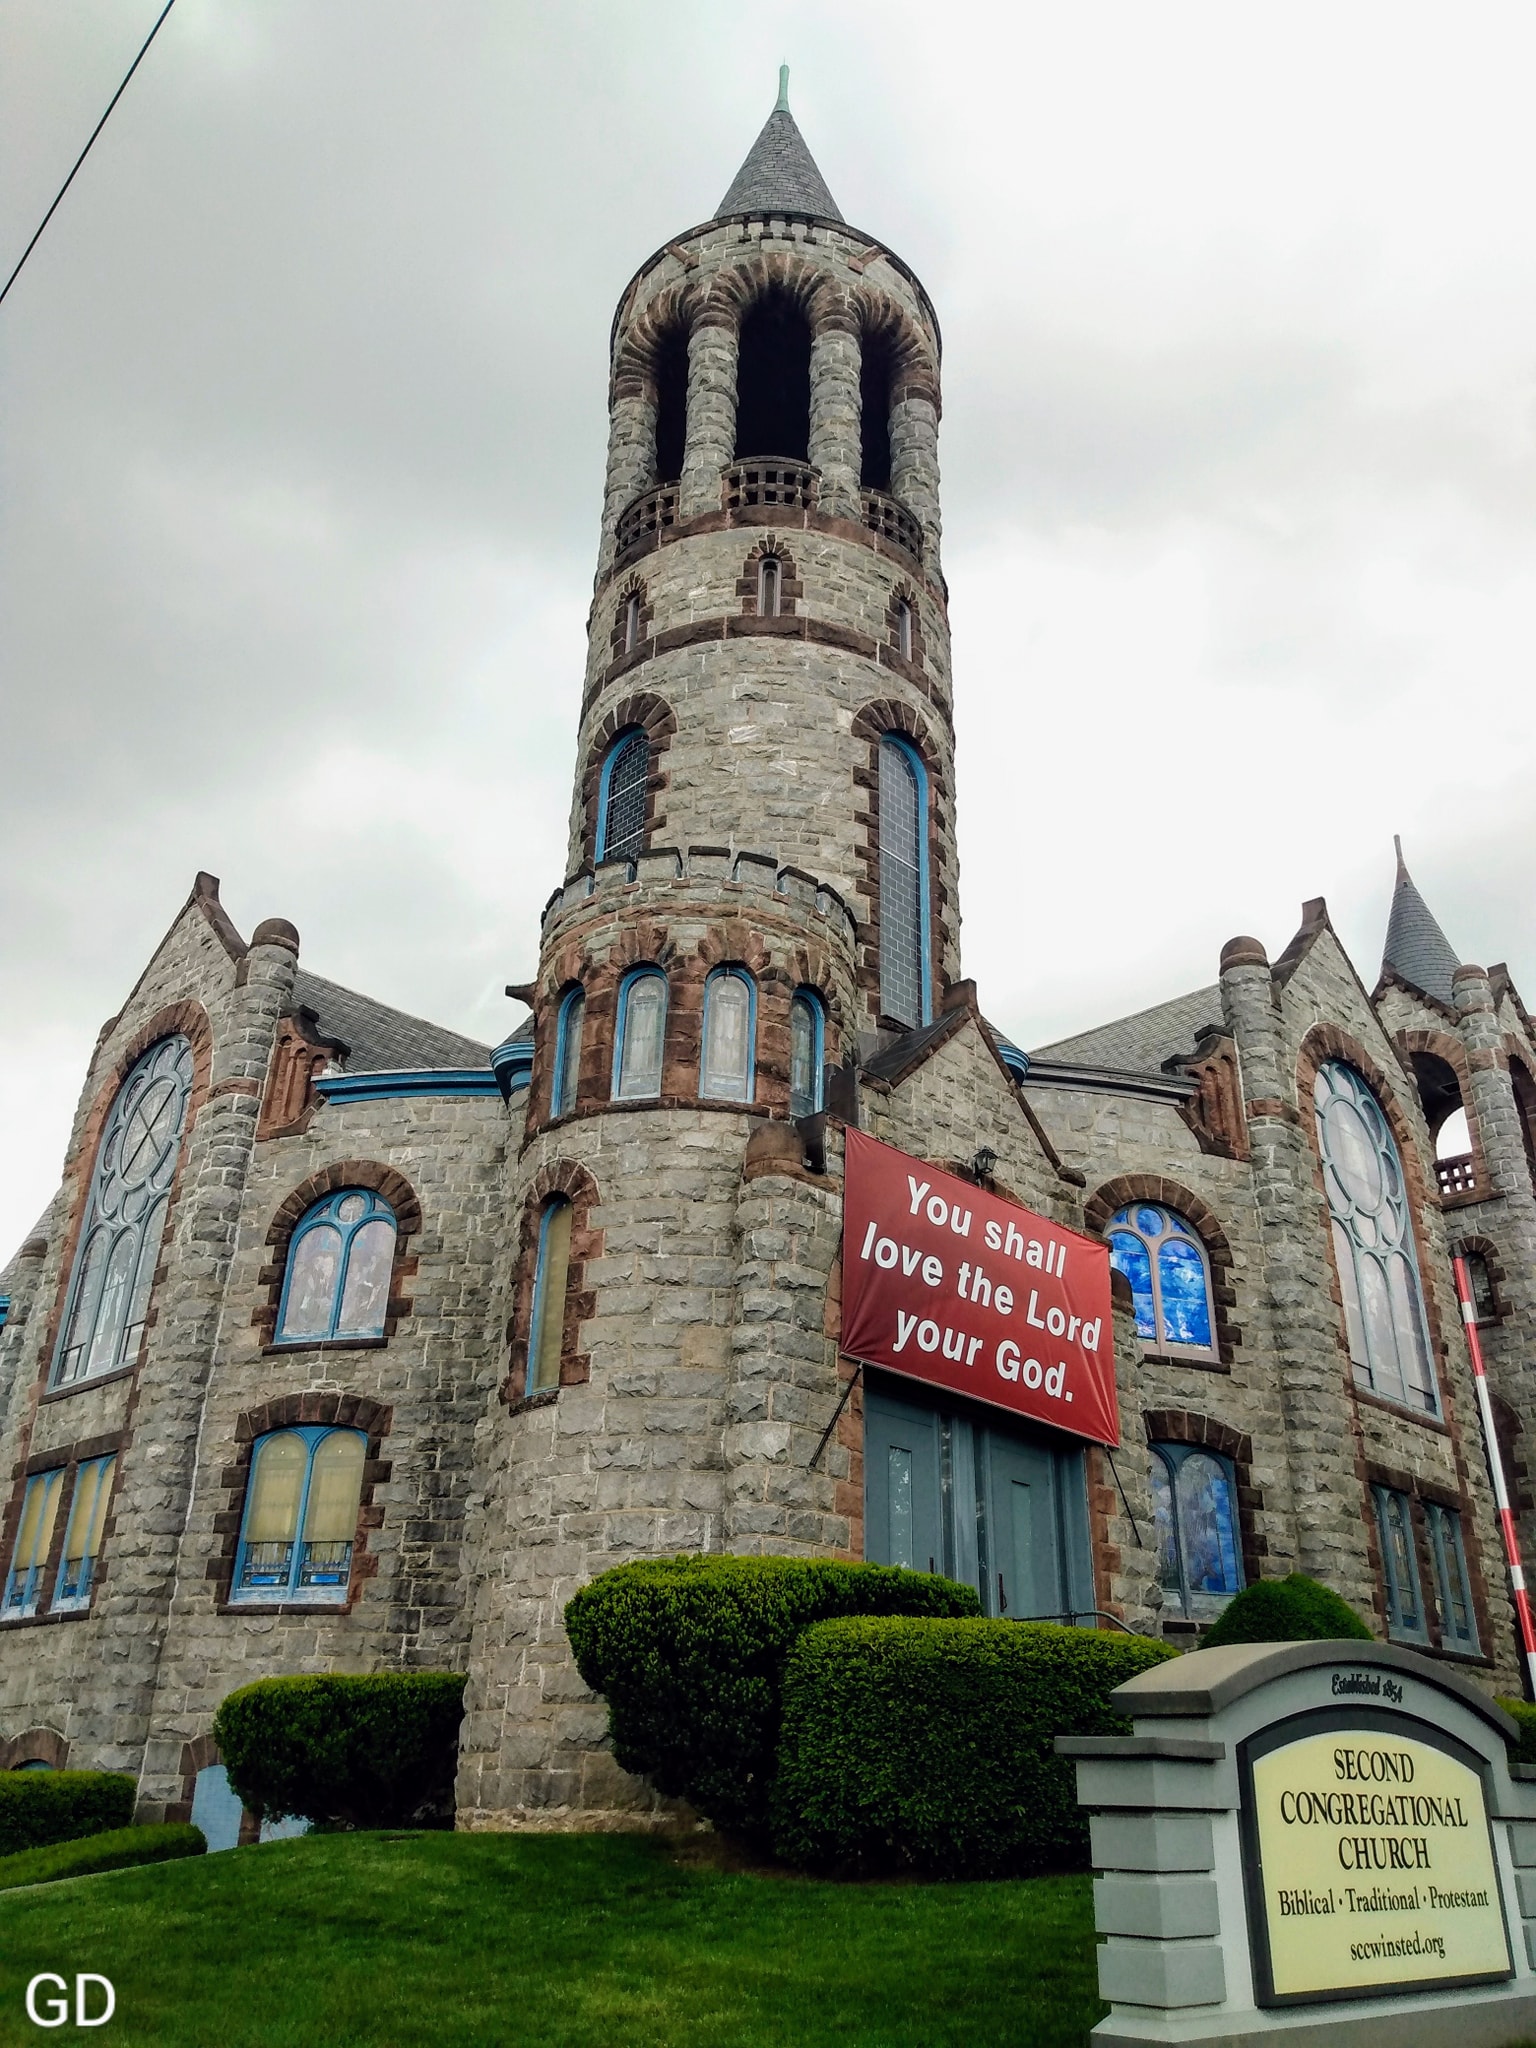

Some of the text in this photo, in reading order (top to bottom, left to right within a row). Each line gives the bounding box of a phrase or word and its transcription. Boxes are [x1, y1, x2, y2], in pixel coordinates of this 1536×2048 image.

[907, 1175, 1067, 1279] You shall
[860, 1221, 1102, 1352] love the Lord
[892, 1309, 1073, 1402] your God.
[1333, 1748, 1414, 1783] SECOND
[1280, 1790, 1468, 1827] CONGREGATIONAL
[1338, 1836, 1431, 1870] CHURCH
[1278, 1885, 1489, 1916] Biblical Traditional Protestant
[1350, 1930, 1446, 1960] sccwinsted.org
